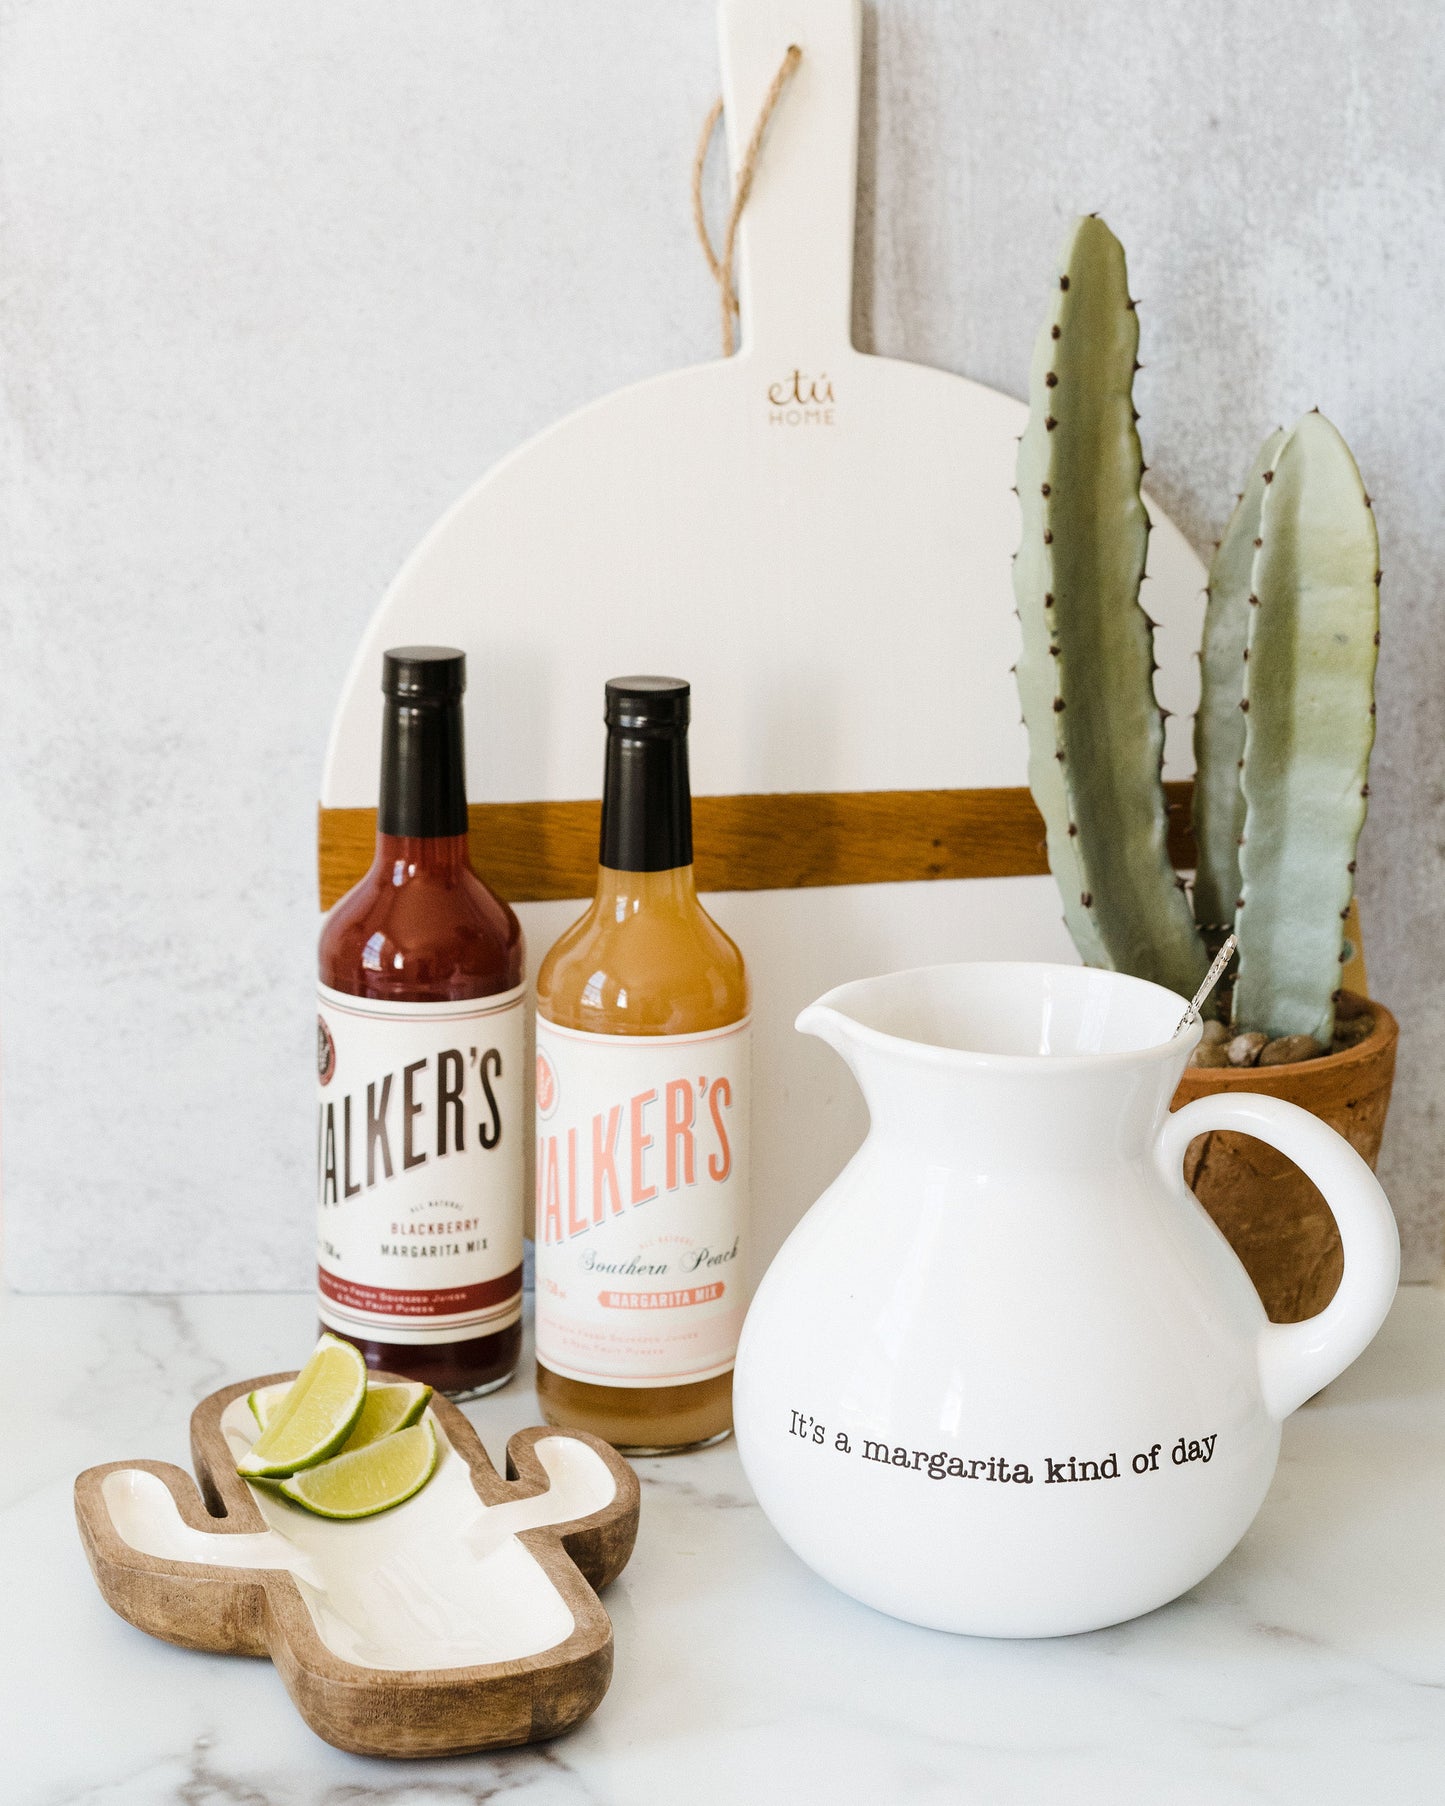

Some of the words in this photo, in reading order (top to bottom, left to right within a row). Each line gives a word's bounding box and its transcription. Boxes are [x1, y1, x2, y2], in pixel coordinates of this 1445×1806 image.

[769, 409, 834, 426] HOME
[317, 1046, 502, 1208] ALKER'S
[391, 1217, 480, 1236] BLACKBERRY
[381, 1243, 460, 1258] MARGARITA
[466, 1238, 489, 1254] MIX
[579, 1247, 668, 1276] Southern
[679, 1235, 741, 1273] Peach
[608, 1291, 690, 1308] MARGARITA
[695, 1285, 718, 1302] MIX
[788, 1408, 826, 1445] It's
[834, 1430, 852, 1454] a
[862, 1438, 1034, 1484] margarita
[1043, 1453, 1121, 1484] kind
[1131, 1444, 1162, 1474] of
[1171, 1433, 1218, 1466] day
